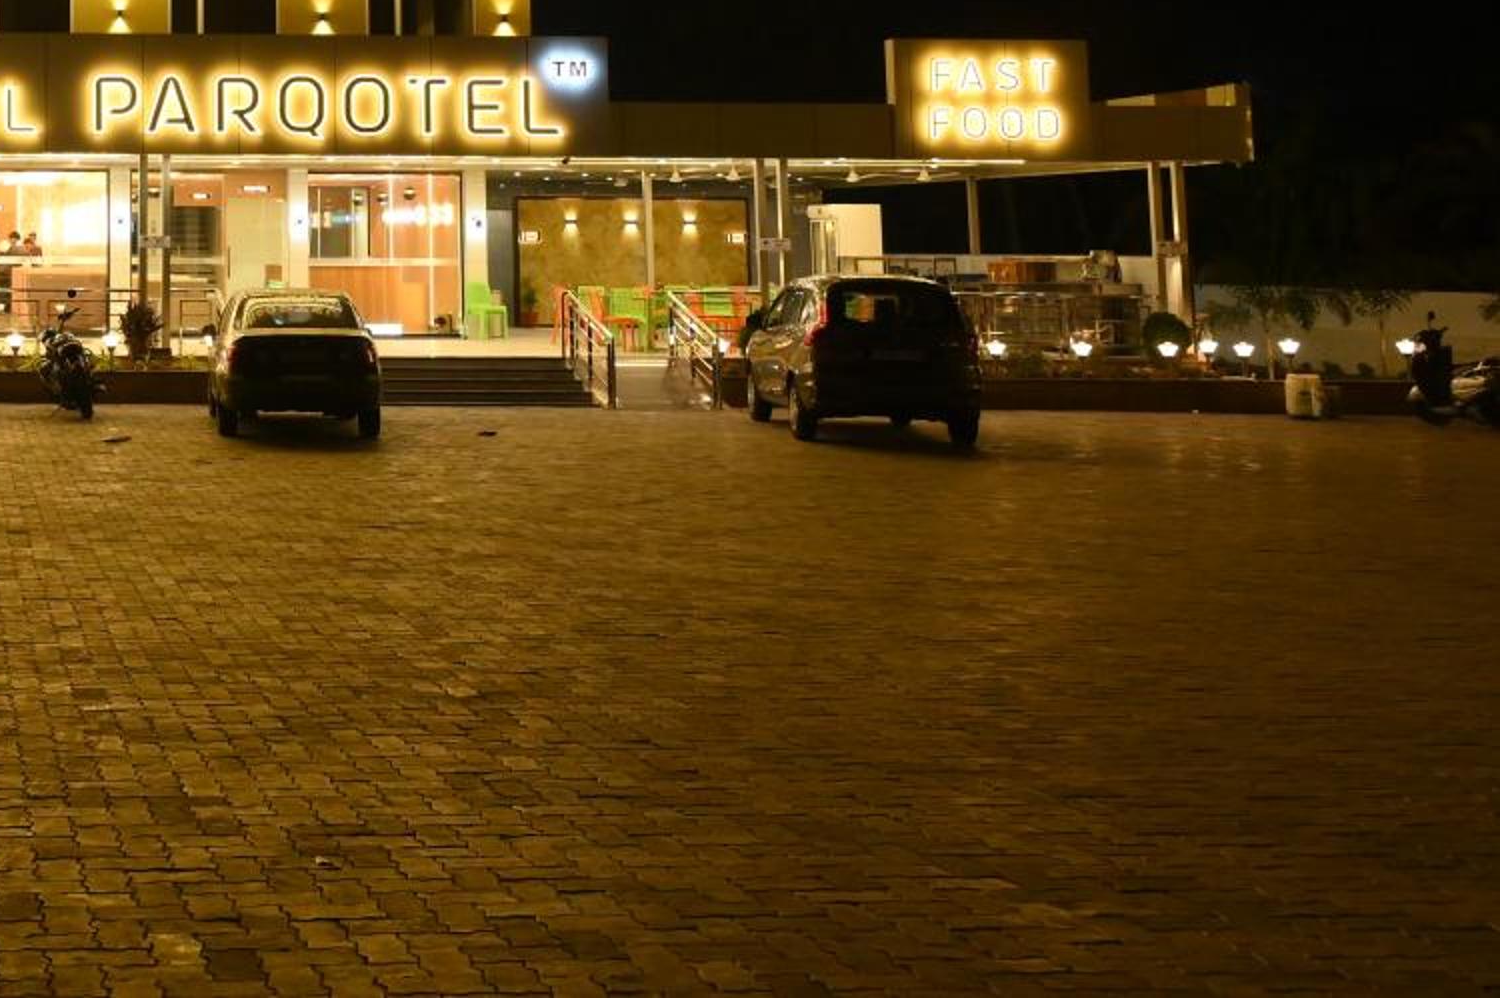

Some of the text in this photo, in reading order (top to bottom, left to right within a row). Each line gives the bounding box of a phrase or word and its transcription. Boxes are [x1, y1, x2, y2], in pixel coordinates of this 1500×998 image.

[551, 60, 589, 78] TM
[930, 57, 1056, 92] FAST
[93, 74, 561, 138] PARQOTEL
[928, 105, 1061, 140] FOOD
